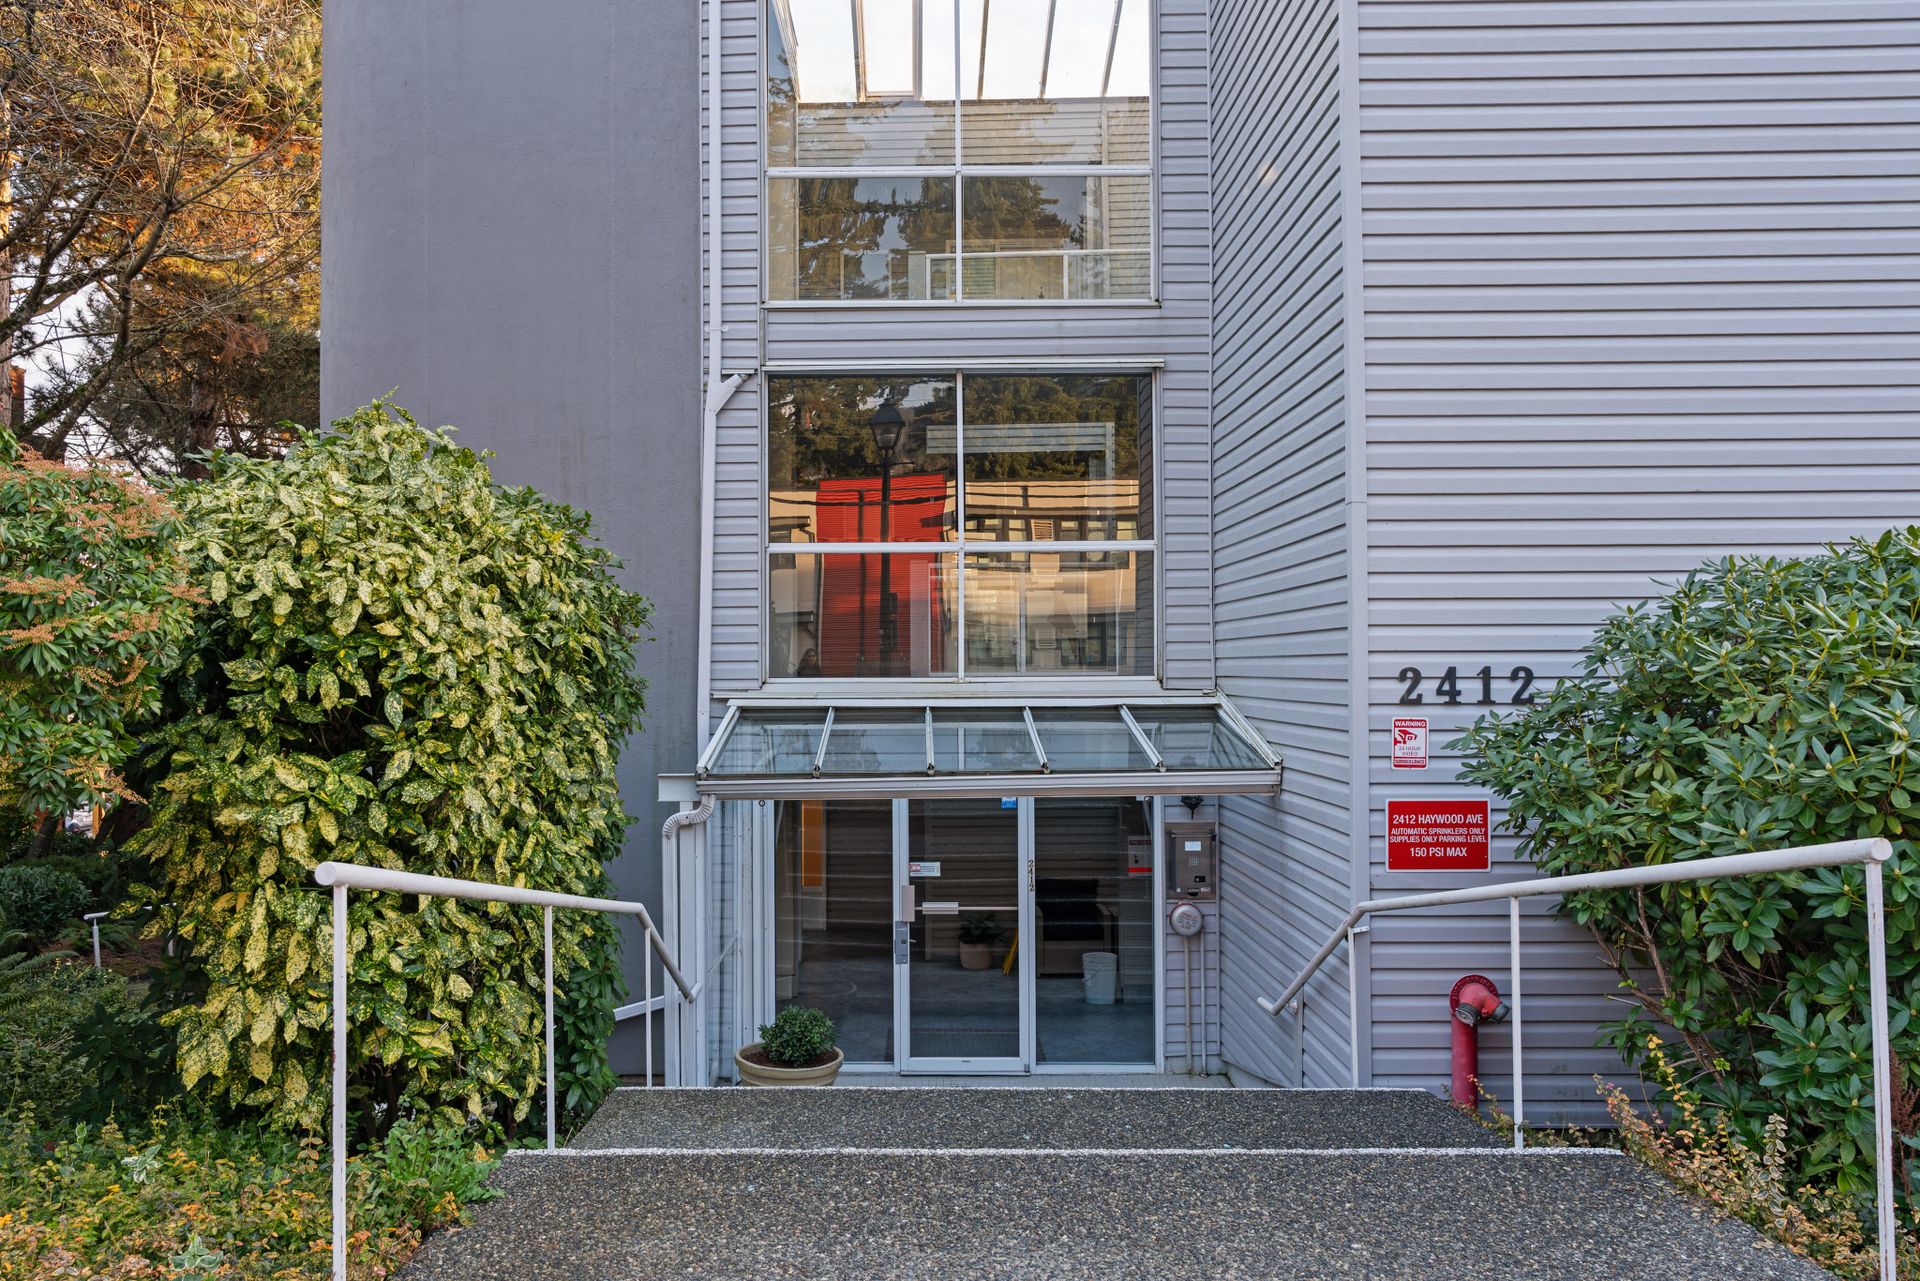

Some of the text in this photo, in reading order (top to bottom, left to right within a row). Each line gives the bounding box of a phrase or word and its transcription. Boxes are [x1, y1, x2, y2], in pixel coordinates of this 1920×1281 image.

[1399, 666, 1534, 704] 2412
[1393, 814, 1483, 824] 2412 HAYWOOD AVE
[1391, 827, 1486, 835] AUTOMATIC SPRINKLERS ONLY
[1389, 835, 1487, 843] SUPPLIES ONLY PARKING LEVEL
[1409, 847, 1468, 857] 150 PSI MAX
